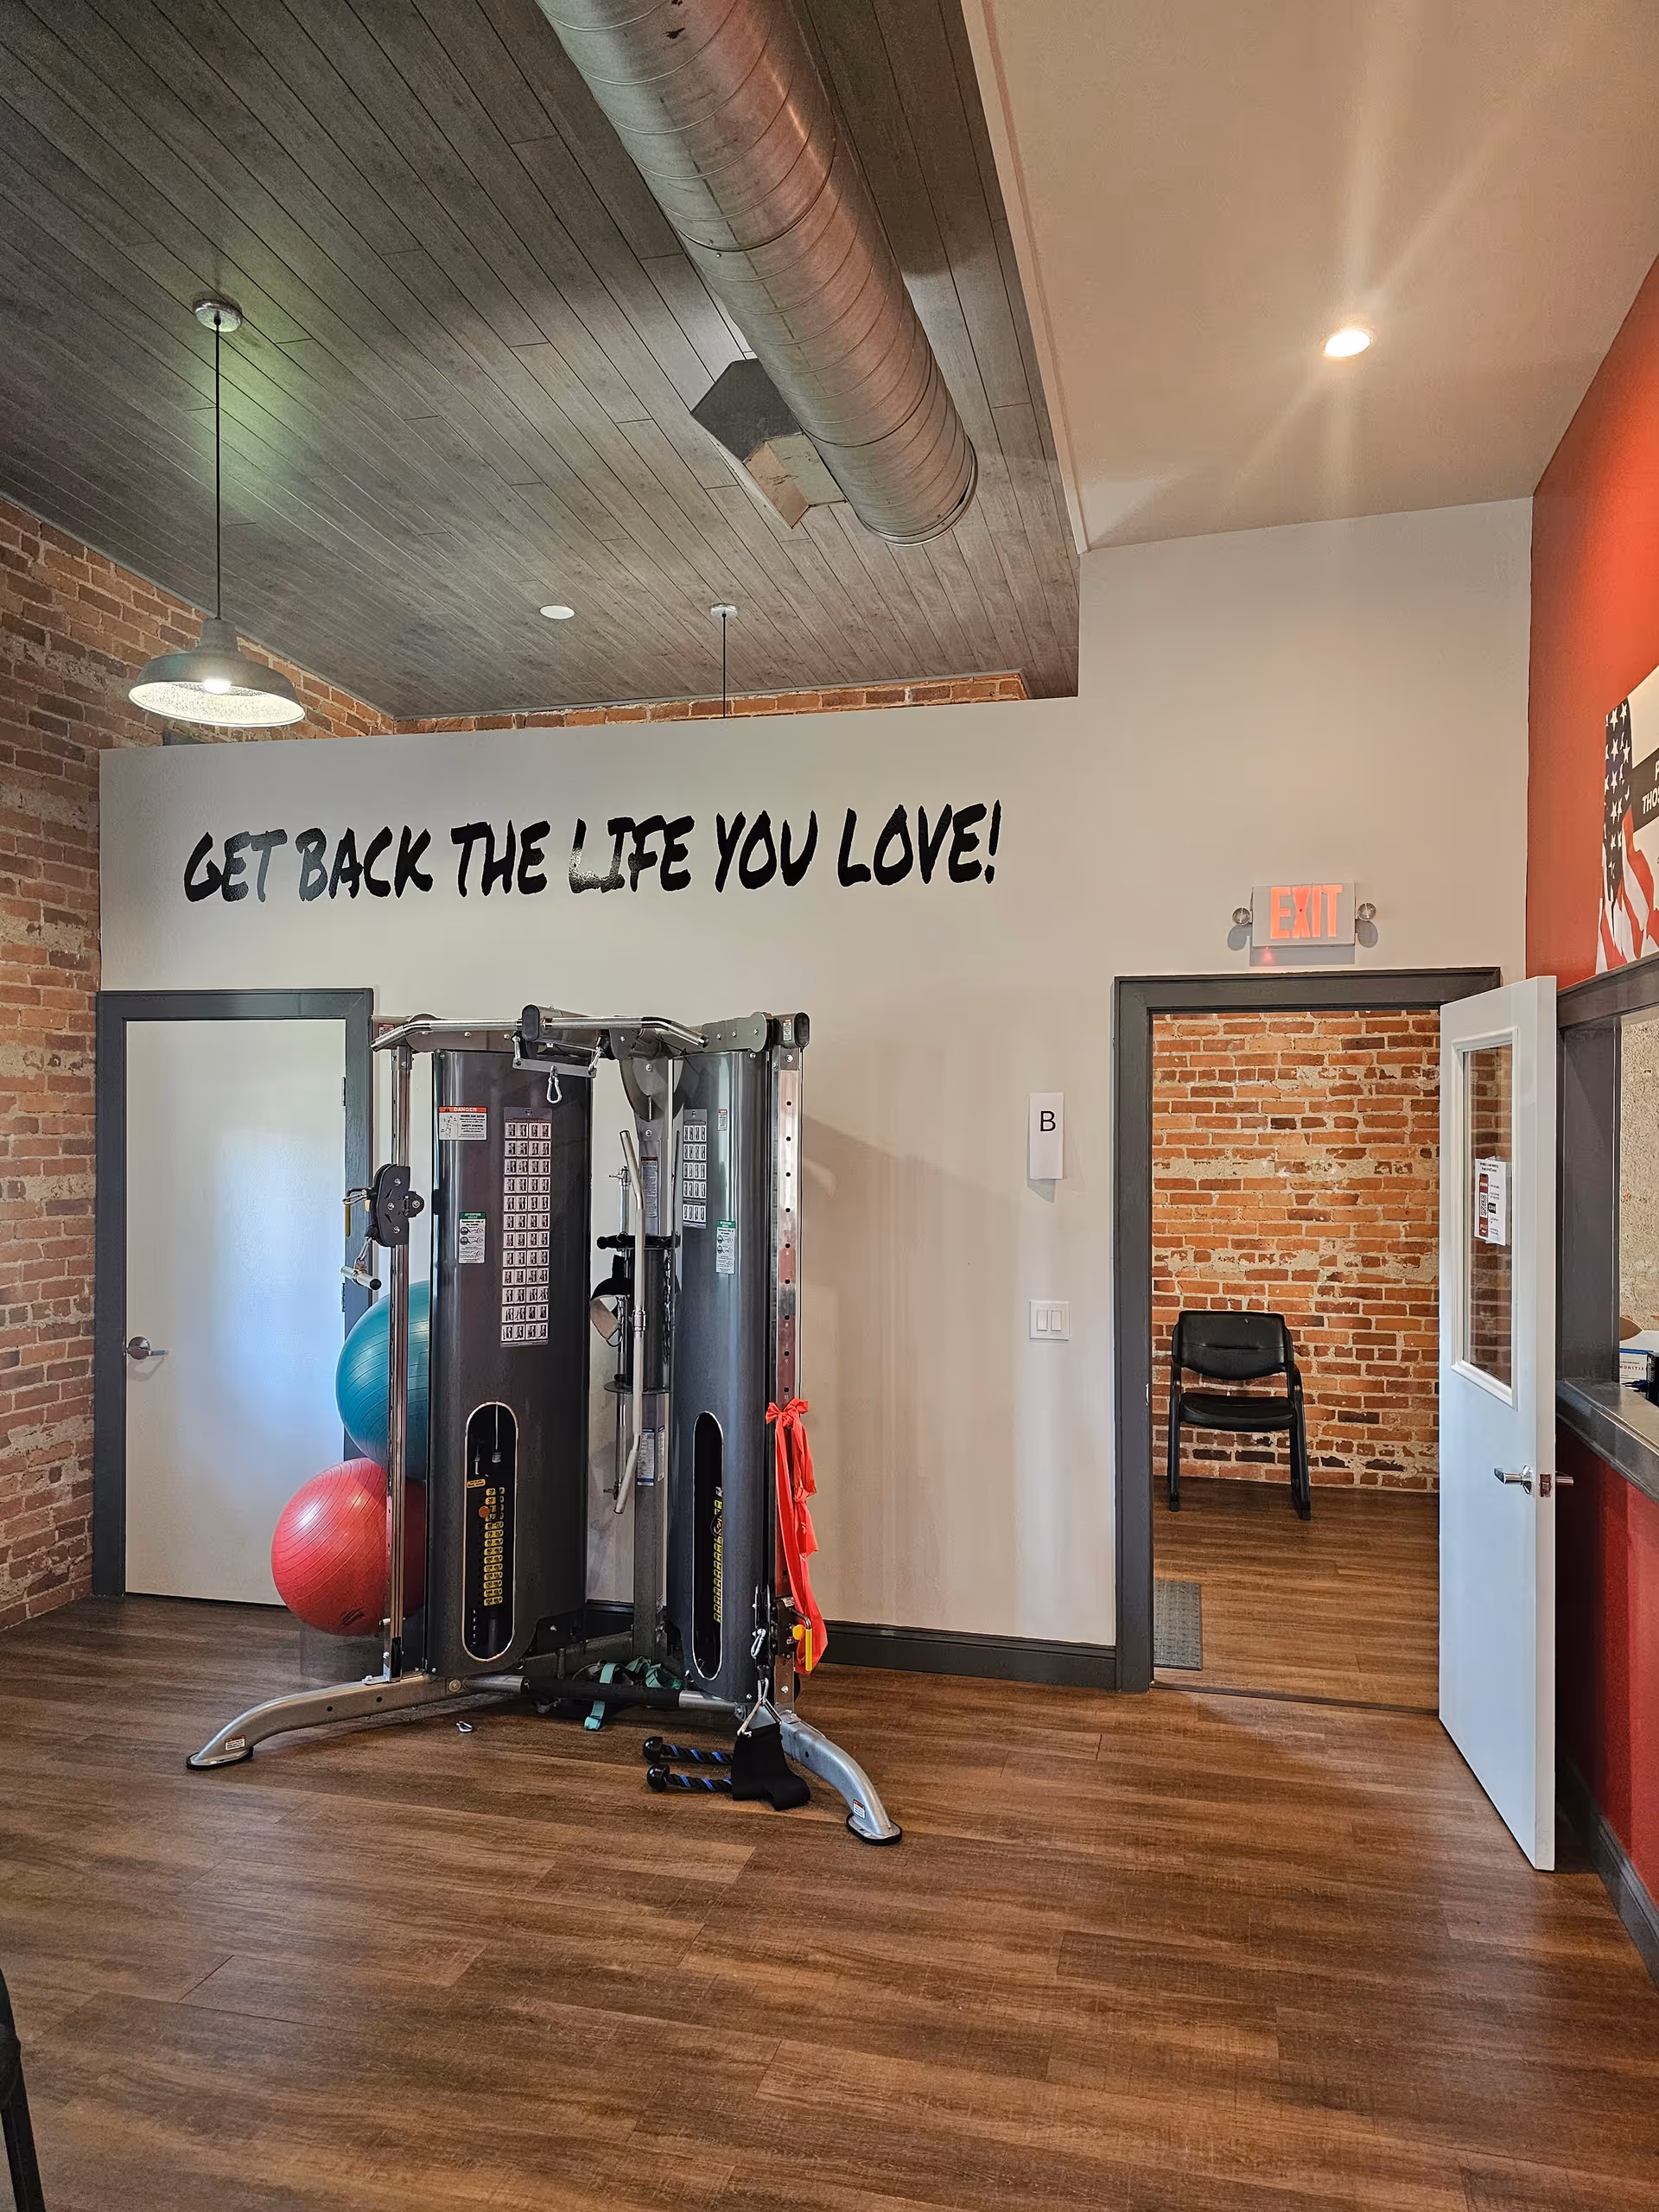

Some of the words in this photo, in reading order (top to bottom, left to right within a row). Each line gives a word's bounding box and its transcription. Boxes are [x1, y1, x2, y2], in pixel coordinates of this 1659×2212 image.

[1642, 786, 1659, 815] THO
[184, 829, 288, 902] GET
[296, 824, 434, 899] BACK
[451, 819, 551, 898] THE
[568, 815, 696, 893] LIFE
[715, 809, 819, 893] YOU
[837, 799, 1001, 887] LOVE!
[1270, 884, 1343, 939] EXIT
[1039, 1110, 1057, 1132] B
